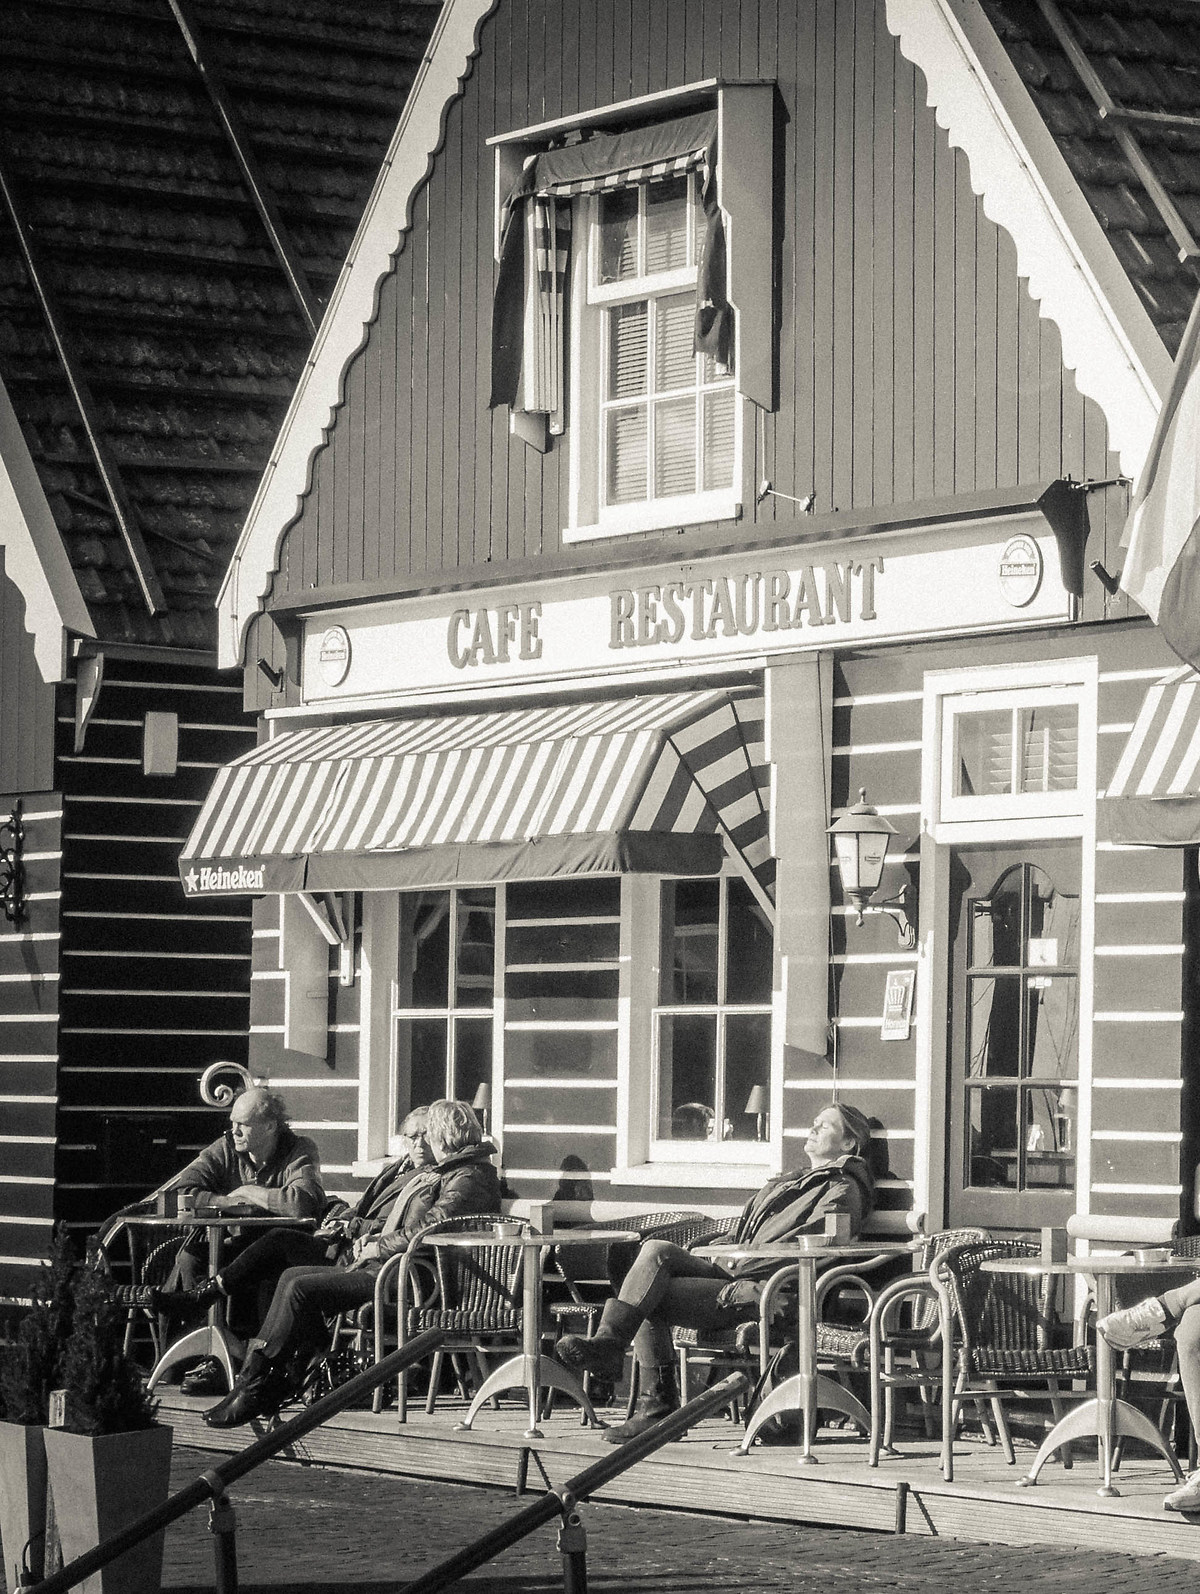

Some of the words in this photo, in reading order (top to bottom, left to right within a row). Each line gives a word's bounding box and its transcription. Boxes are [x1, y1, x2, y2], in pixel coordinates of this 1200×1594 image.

[447, 601, 543, 669] CAFE
[608, 556, 884, 649] RESTAURANT
[200, 865, 264, 890] Heineken
